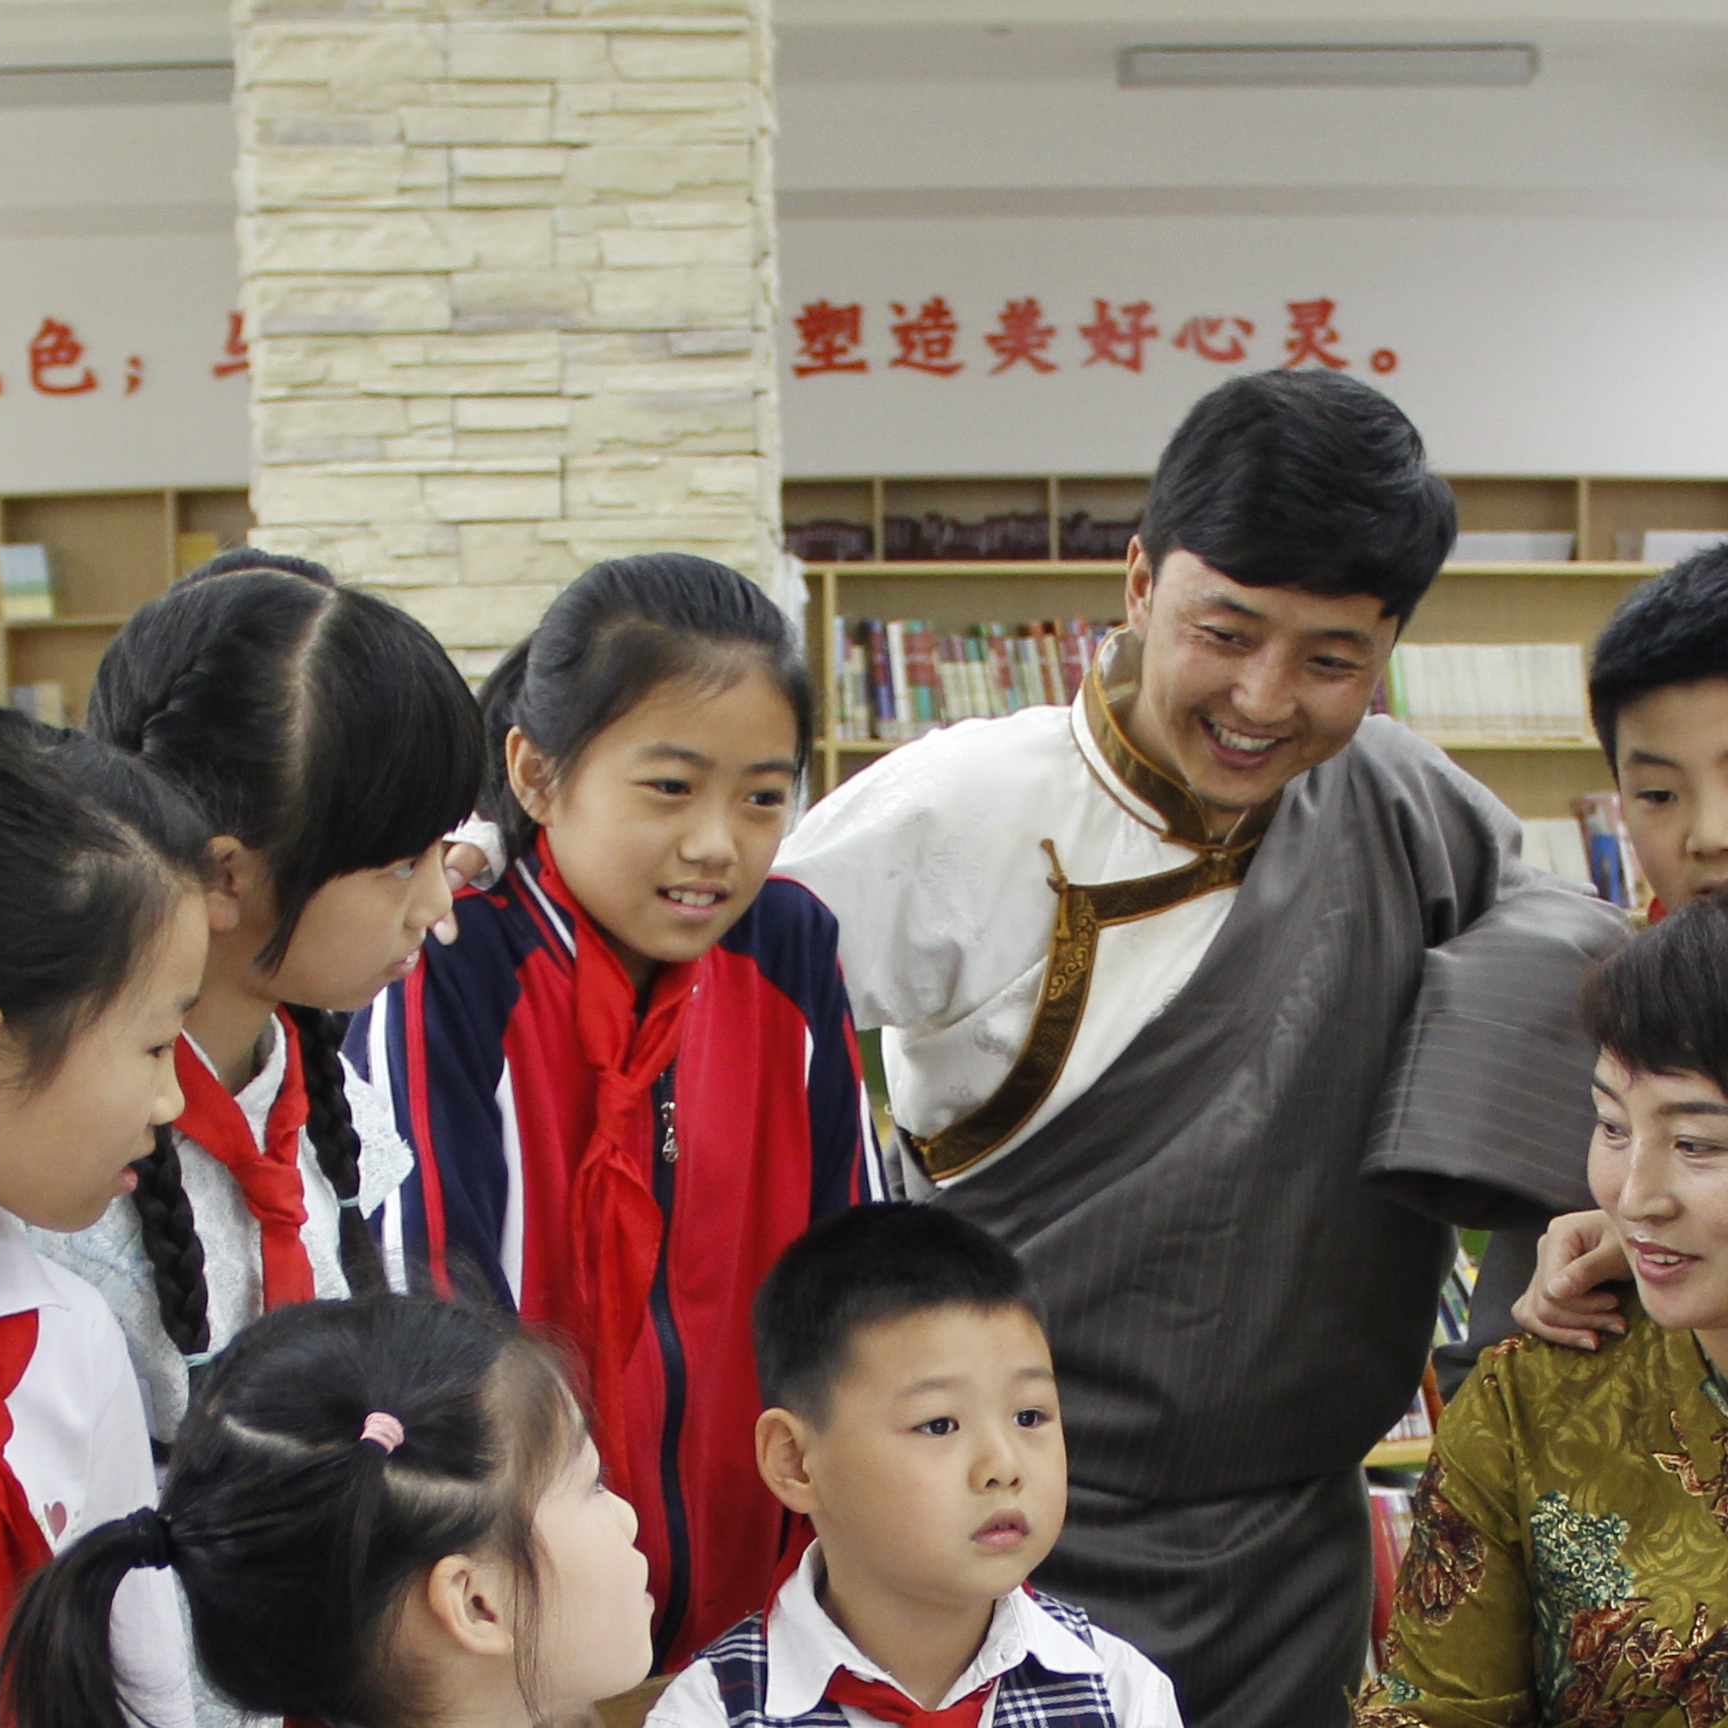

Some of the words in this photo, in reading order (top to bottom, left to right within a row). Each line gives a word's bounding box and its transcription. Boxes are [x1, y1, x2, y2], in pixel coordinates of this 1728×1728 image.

[792, 298, 1400, 378] 塑造美好心灵。
